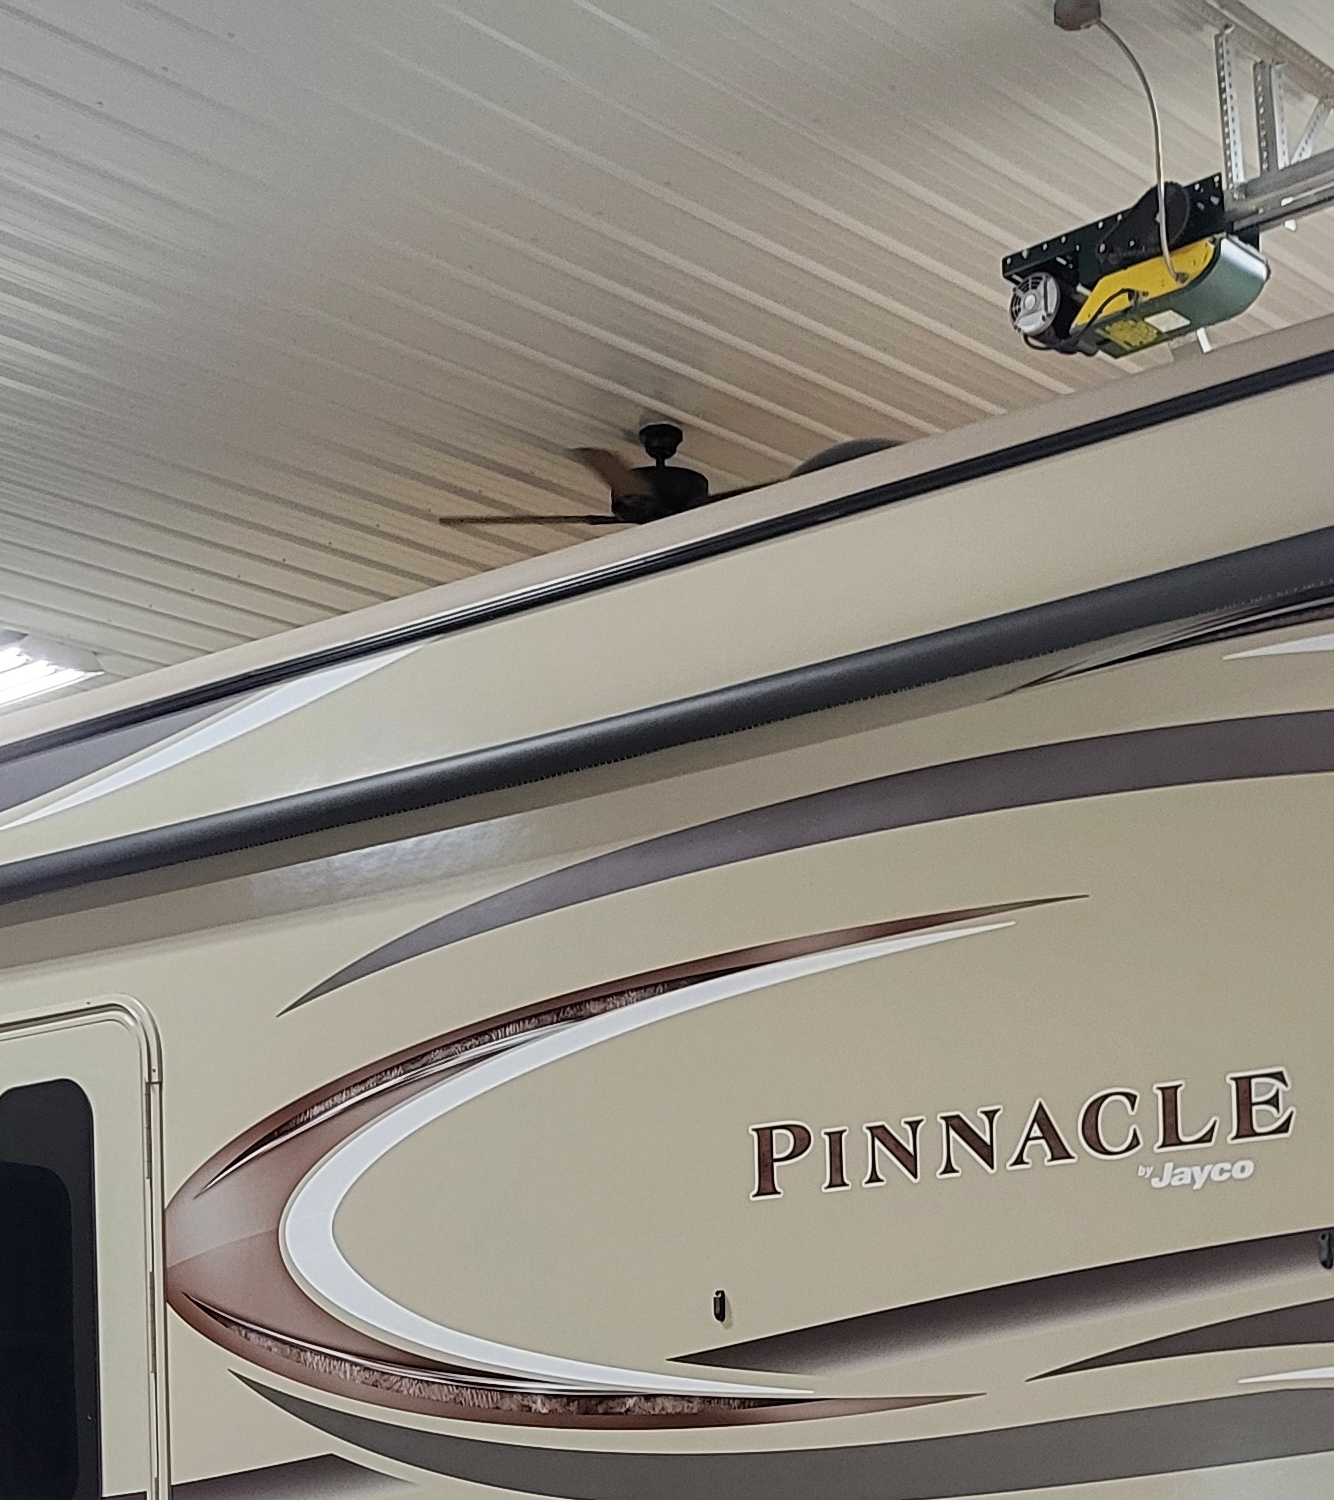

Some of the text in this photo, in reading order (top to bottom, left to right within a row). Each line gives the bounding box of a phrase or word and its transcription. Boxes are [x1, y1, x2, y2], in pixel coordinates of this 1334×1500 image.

[750, 1066, 1296, 1200] PINNACLE
[1138, 1160, 1254, 1190] by Jayco
